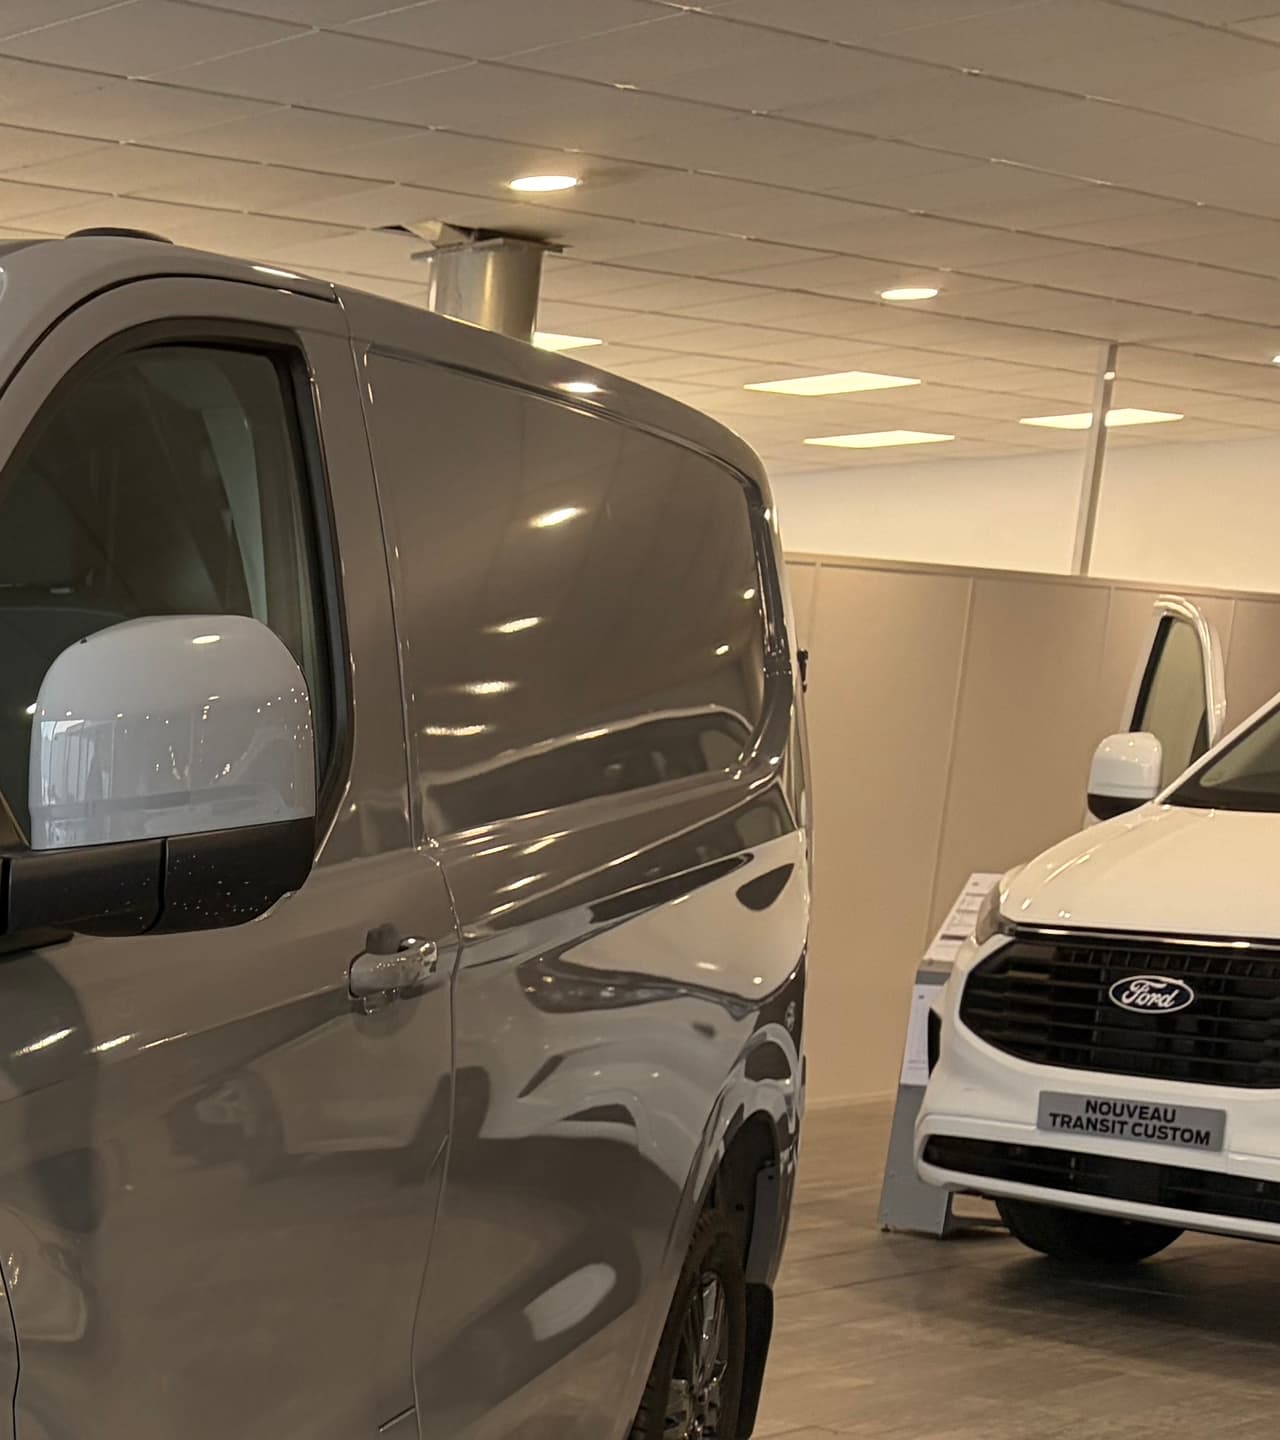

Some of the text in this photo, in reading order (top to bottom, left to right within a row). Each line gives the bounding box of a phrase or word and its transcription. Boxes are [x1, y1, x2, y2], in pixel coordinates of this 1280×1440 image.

[1121, 979, 1180, 1008] Ford
[1084, 1099, 1177, 1124] NOUVEAU
[1049, 1112, 1212, 1147] TRANSIT CUSTOM
